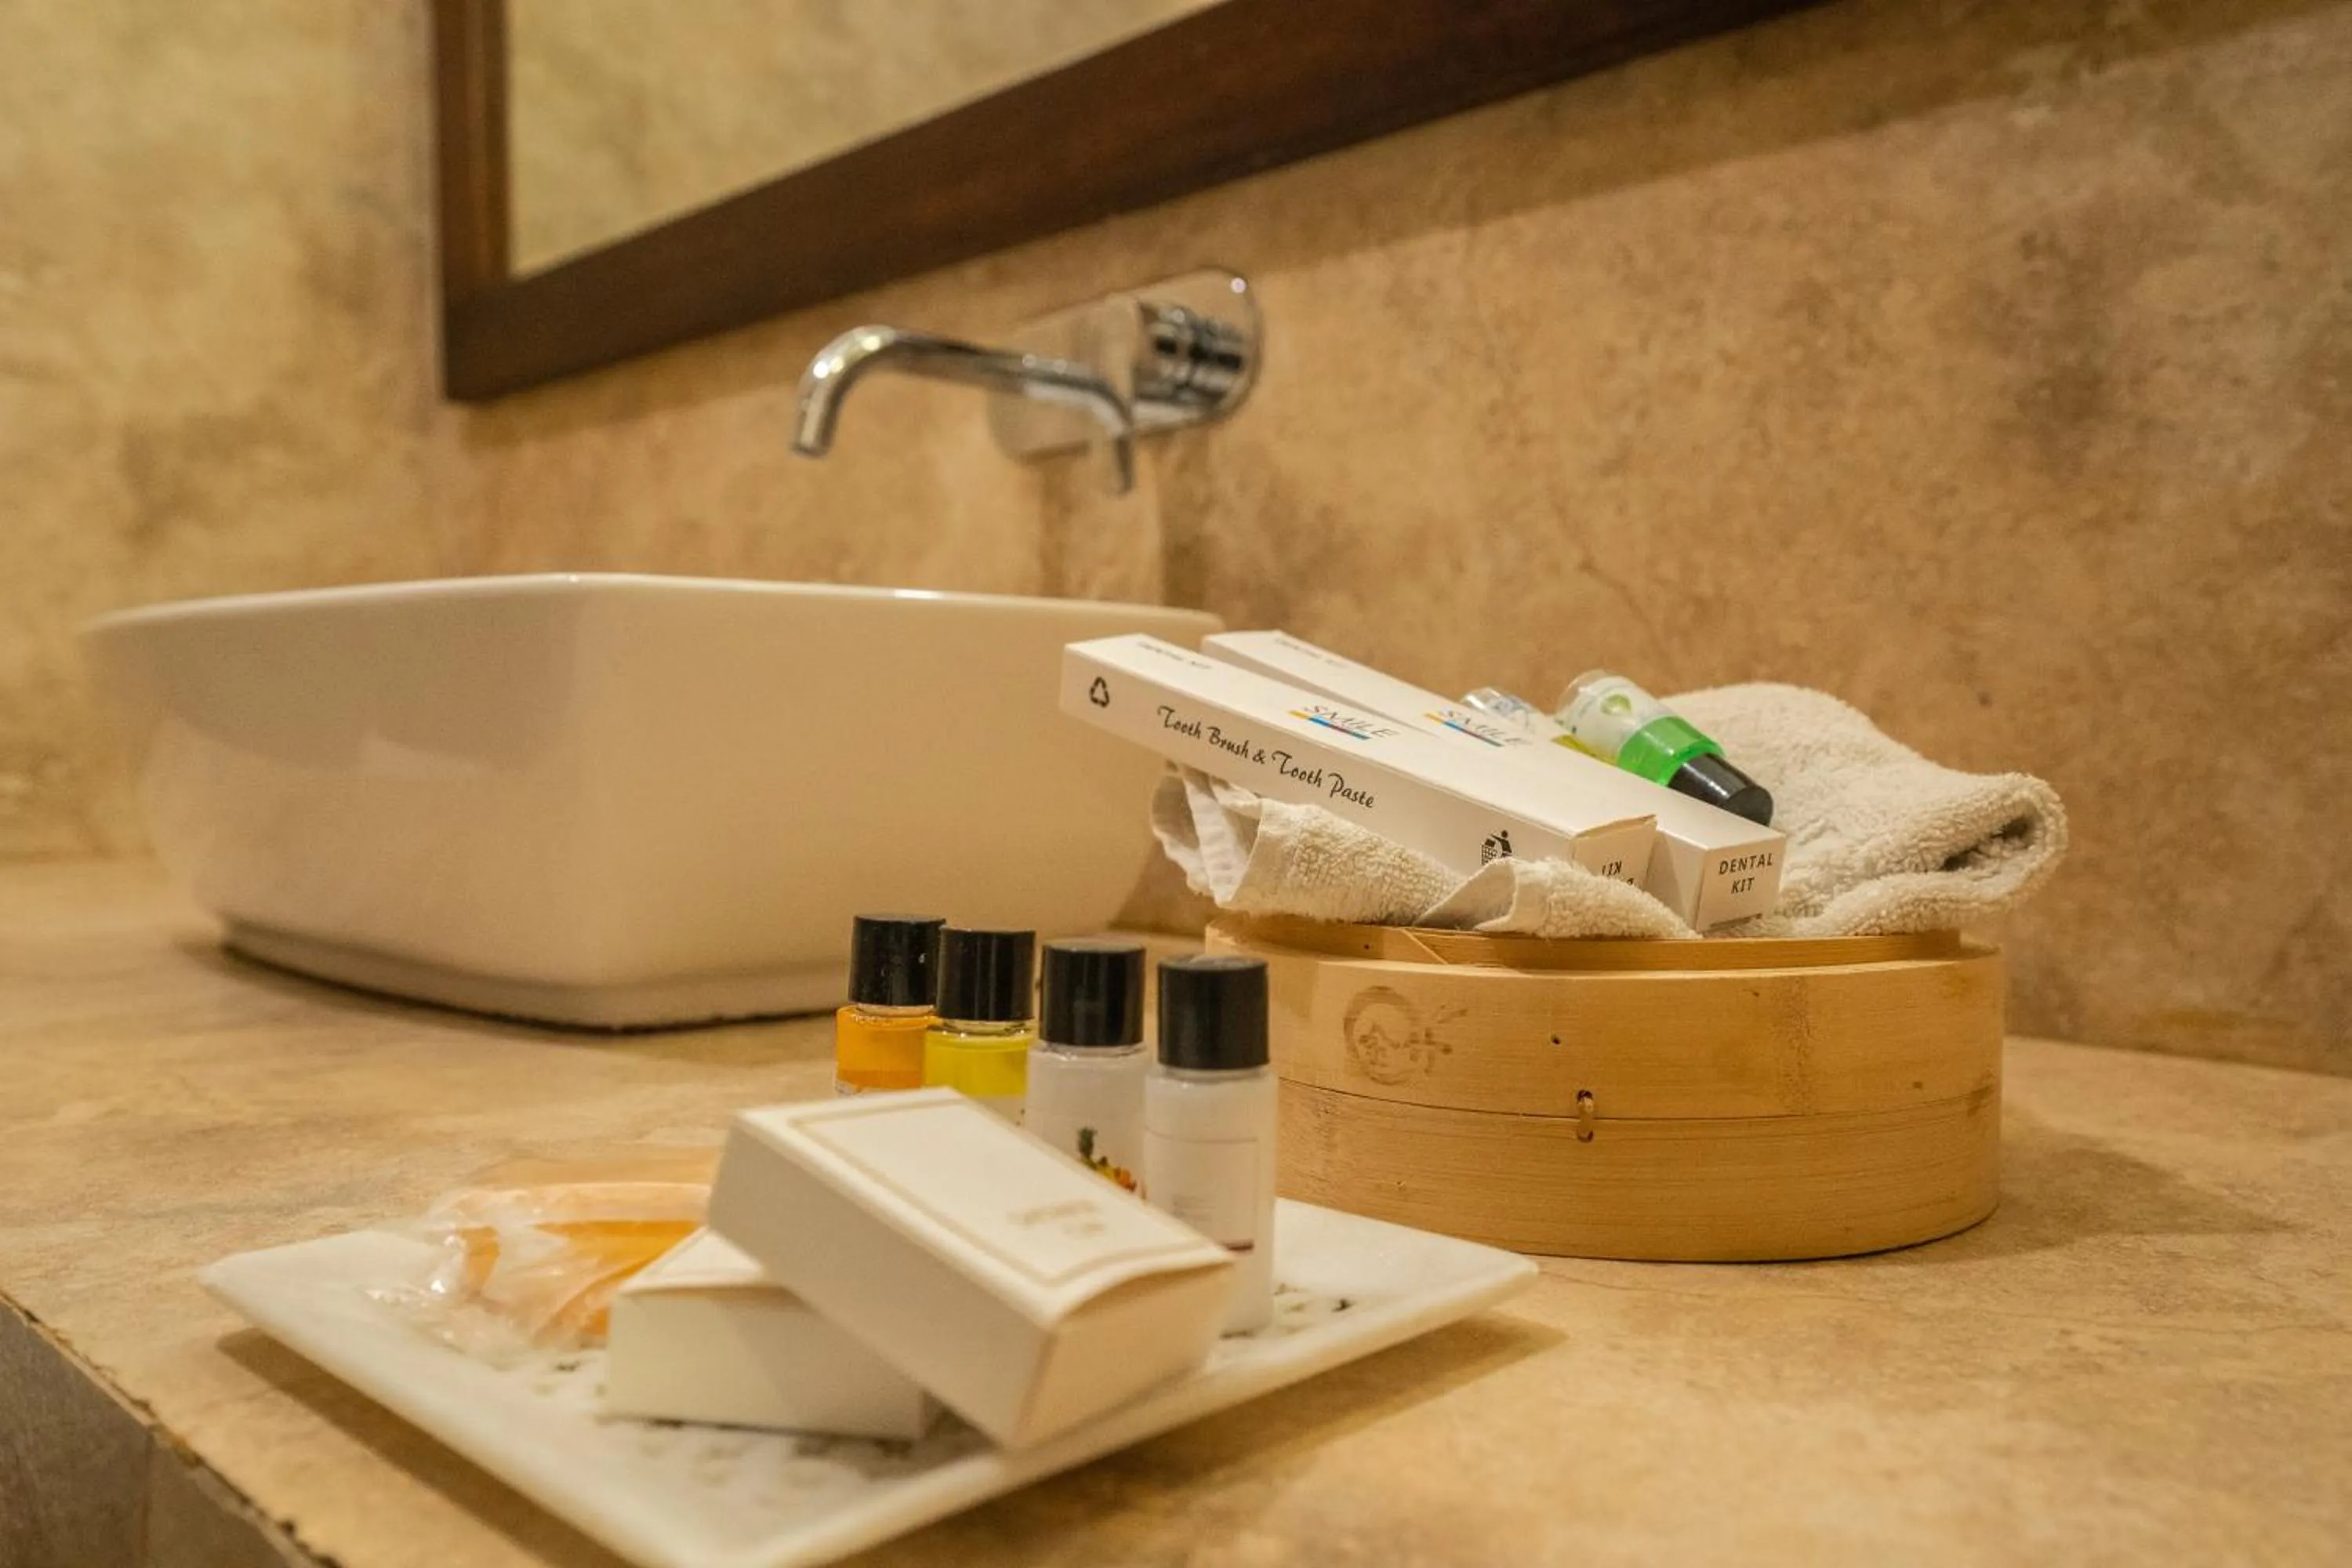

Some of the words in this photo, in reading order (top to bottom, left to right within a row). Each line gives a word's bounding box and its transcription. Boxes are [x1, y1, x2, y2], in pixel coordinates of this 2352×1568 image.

[1304, 705, 1401, 739] SMILE
[1157, 705, 1202, 739] Tooth
[1207, 725, 1250, 759] Brush
[1252, 749, 1265, 764] &
[1271, 750, 1323, 788] Tooth
[1327, 771, 1375, 808] Paste
[1719, 852, 1773, 875] DENTAL
[1730, 877, 1755, 895] KIT
